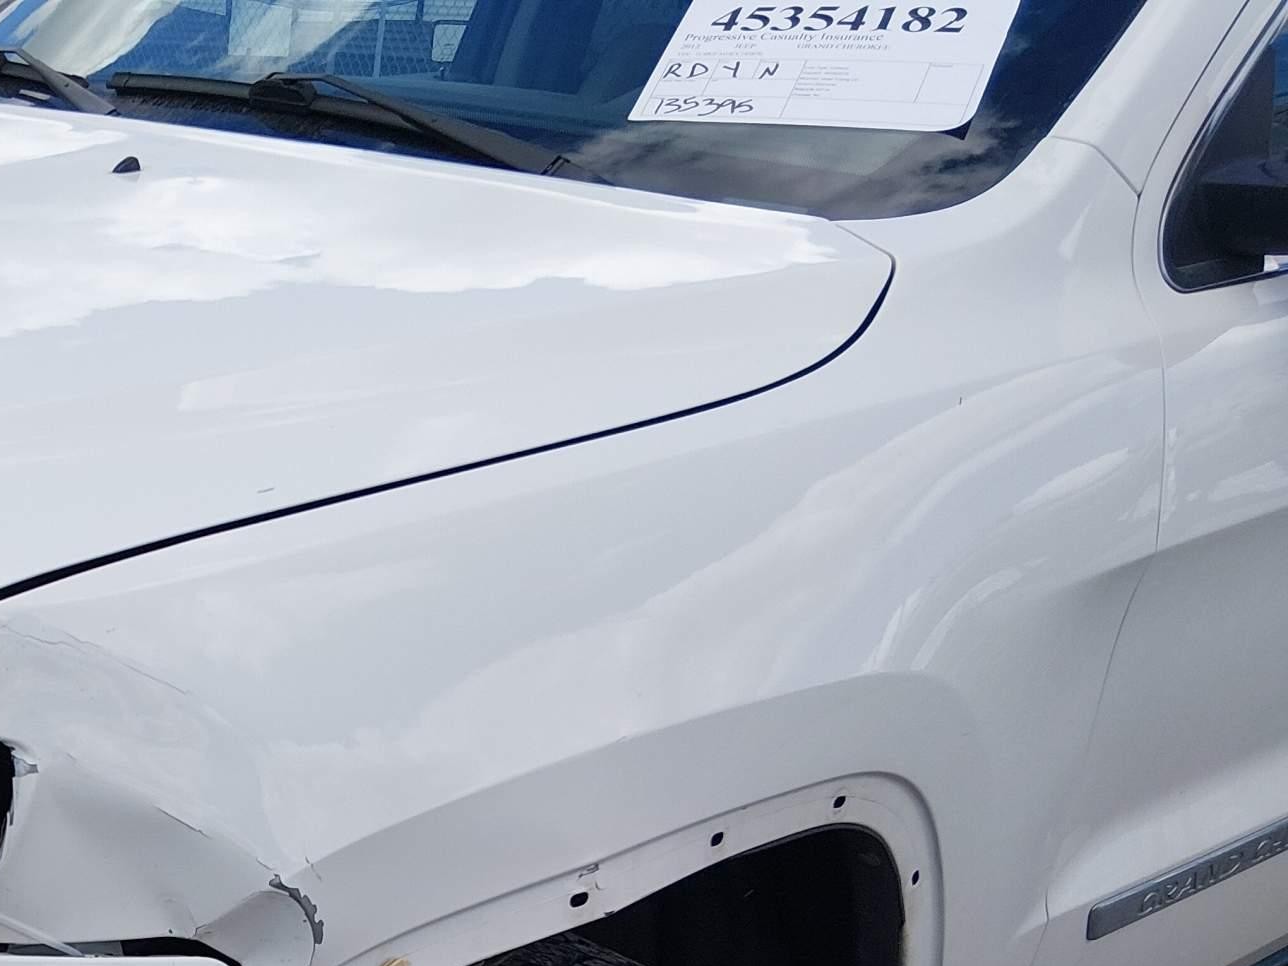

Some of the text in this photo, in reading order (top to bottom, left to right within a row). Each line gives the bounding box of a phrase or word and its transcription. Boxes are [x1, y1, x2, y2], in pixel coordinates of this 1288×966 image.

[710, 5, 968, 33] 45354182
[684, 33, 885, 42] Progressive Casualty Insurance
[758, 63, 780, 80] N
